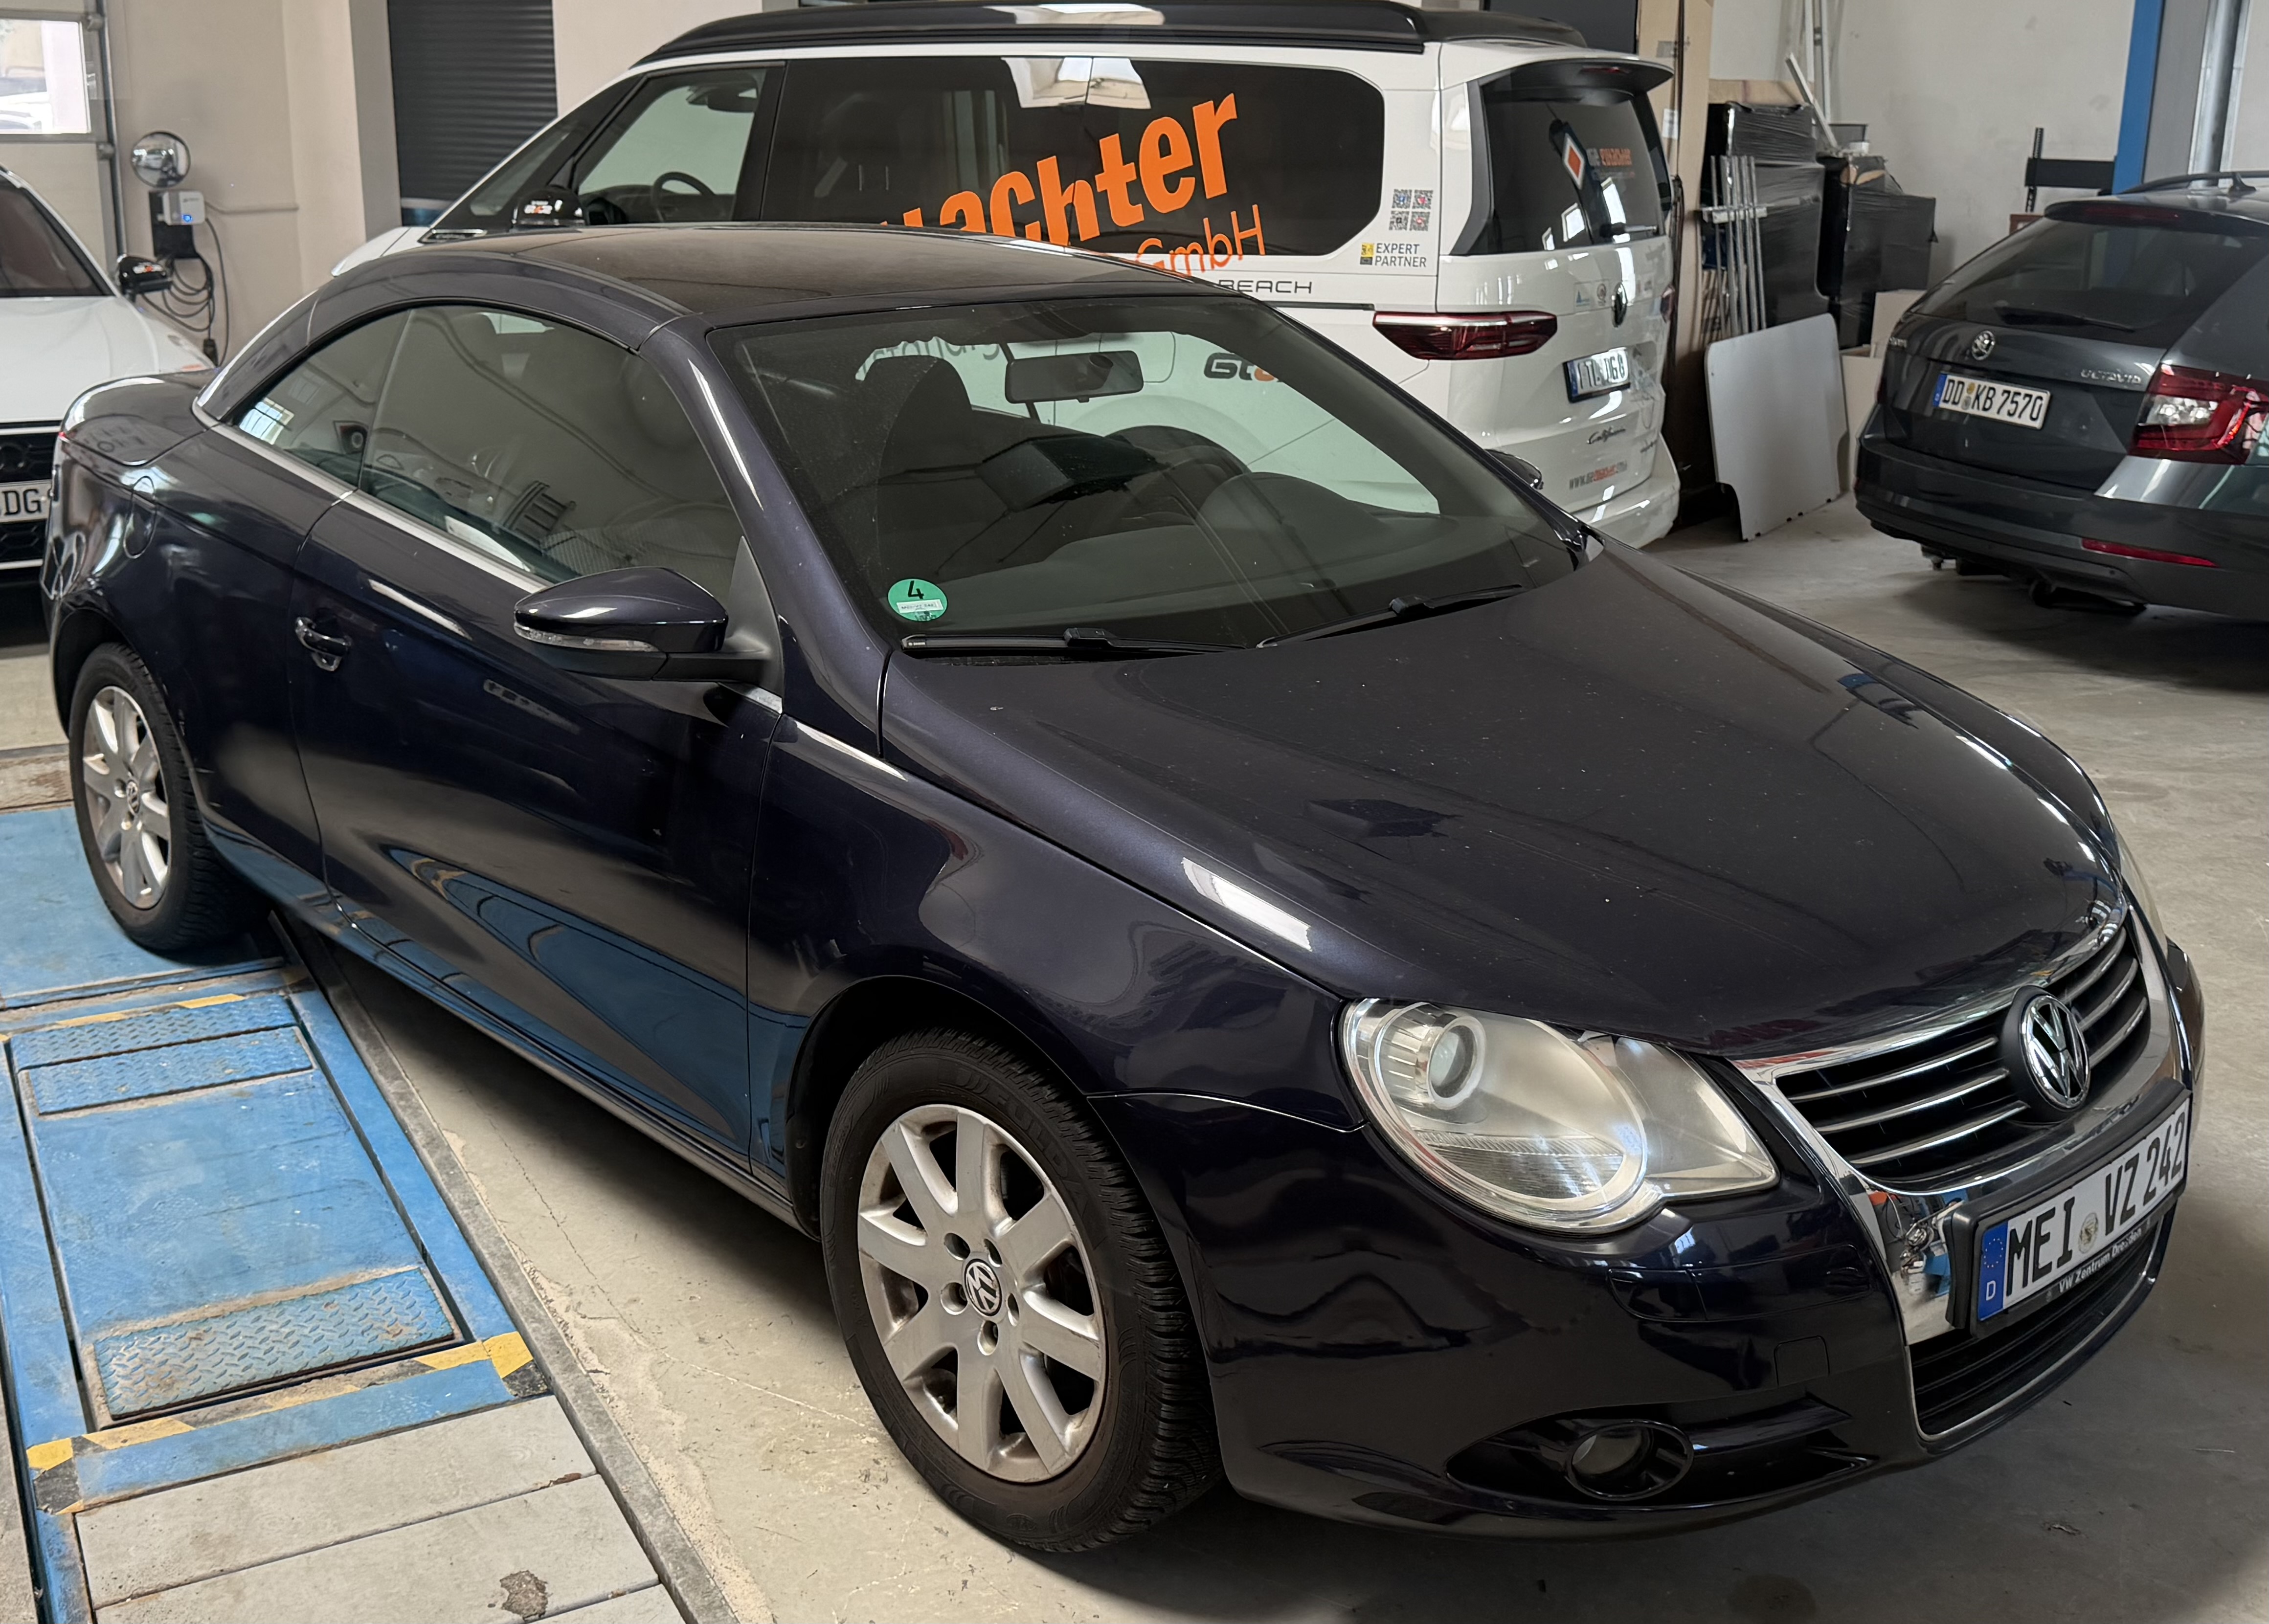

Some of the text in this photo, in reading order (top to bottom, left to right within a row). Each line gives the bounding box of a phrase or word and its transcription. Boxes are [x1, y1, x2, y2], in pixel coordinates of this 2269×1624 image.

[1376, 243, 1419, 254] EXPERT
[1375, 256, 1427, 267] PARTNER
[1219, 279, 1312, 294] BEACH
[1942, 379, 2044, 421] DD KB 7570
[2, 489, 42, 516] DG
[908, 580, 924, 599] 4
[2006, 1112, 2185, 1297] MEI VZ 242
[2059, 1274, 2073, 1293] VW
[2075, 1253, 2110, 1283] Zentrum
[1986, 1280, 1996, 1301] D
